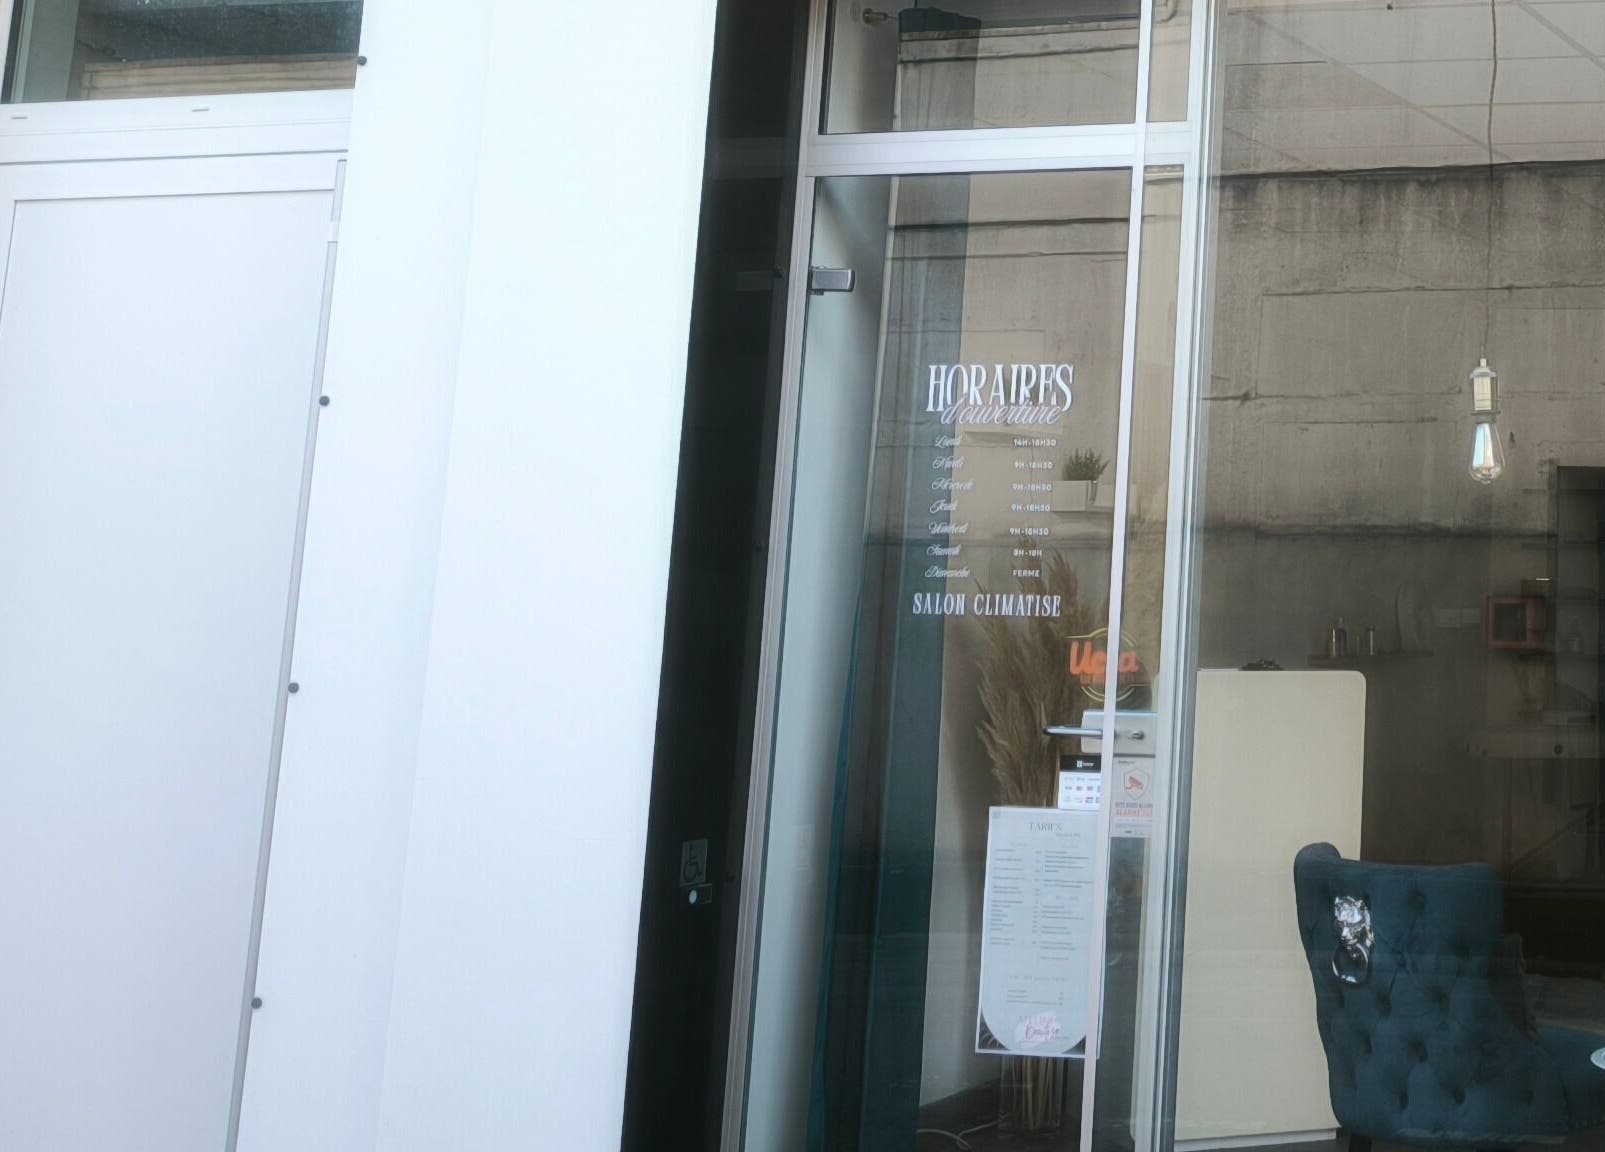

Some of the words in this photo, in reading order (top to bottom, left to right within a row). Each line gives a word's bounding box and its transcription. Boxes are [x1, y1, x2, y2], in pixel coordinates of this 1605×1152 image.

[925, 363, 1075, 412] HORAIRES
[912, 592, 966, 616] SALON
[973, 593, 1062, 618] CLIMATISE
